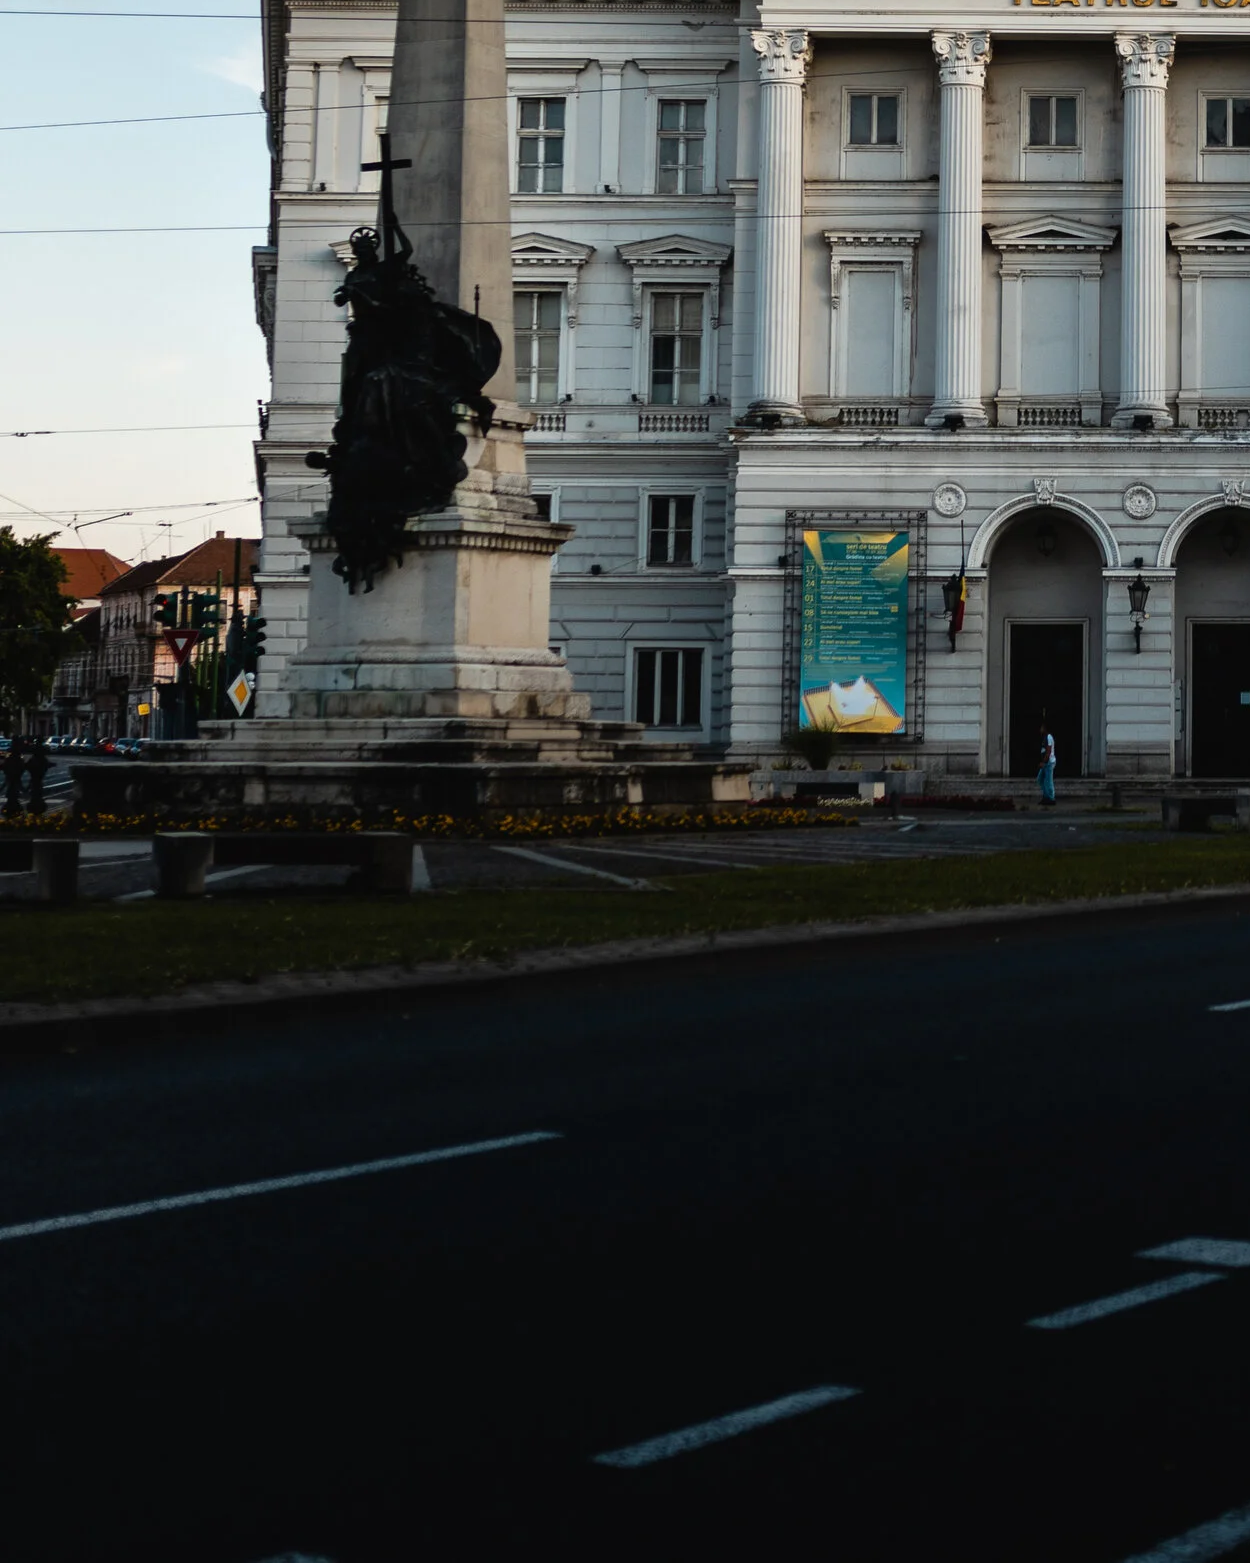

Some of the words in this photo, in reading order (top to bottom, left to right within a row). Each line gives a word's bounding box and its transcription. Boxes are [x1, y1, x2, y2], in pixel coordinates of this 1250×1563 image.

[805, 565, 815, 573] 17
[804, 594, 814, 602] 01
[803, 638, 813, 646] 22
